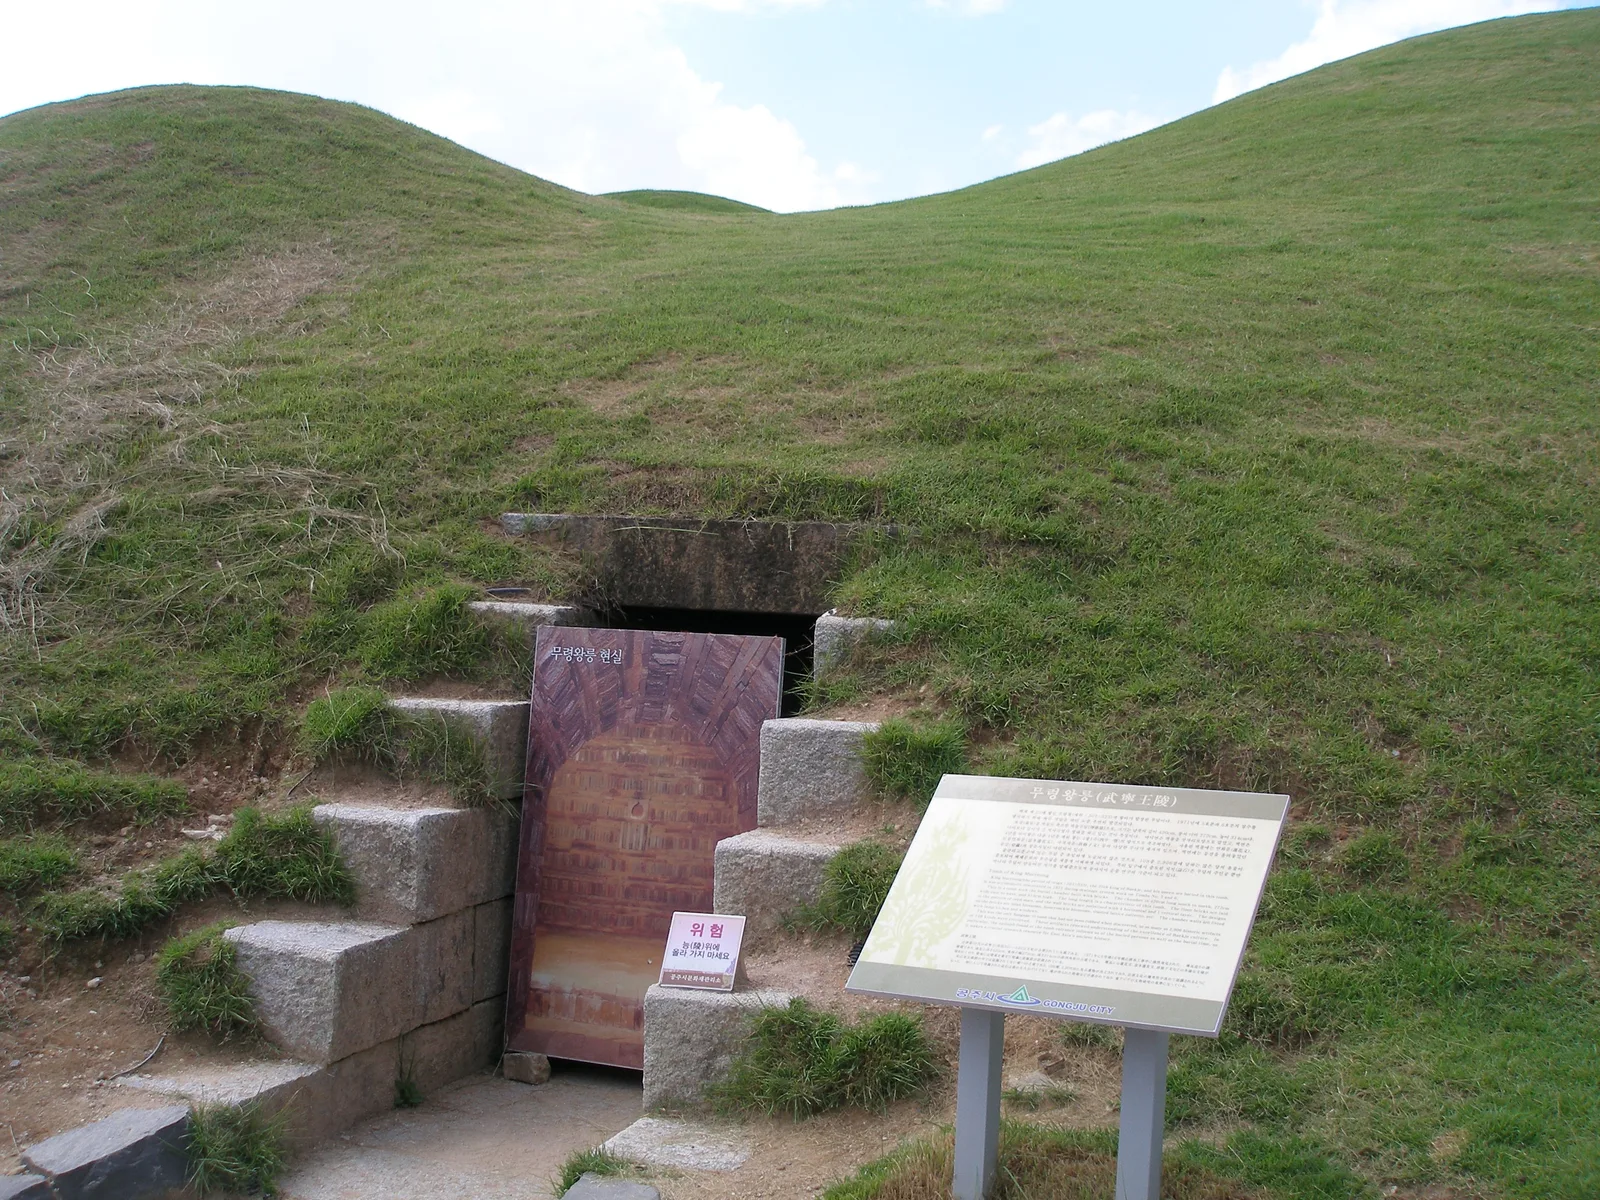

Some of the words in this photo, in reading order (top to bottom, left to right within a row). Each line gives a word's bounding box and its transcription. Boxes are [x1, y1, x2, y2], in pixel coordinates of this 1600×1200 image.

[551, 646, 597, 663] 무령왕릉
[600, 648, 622, 665] 현실
[689, 950, 705, 958] 가지
[707, 951, 730, 960] 마세요
[956, 988, 996, 1001] 공주시
[1043, 1000, 1087, 1012] GONGJU
[1089, 1005, 1114, 1015] CITY
